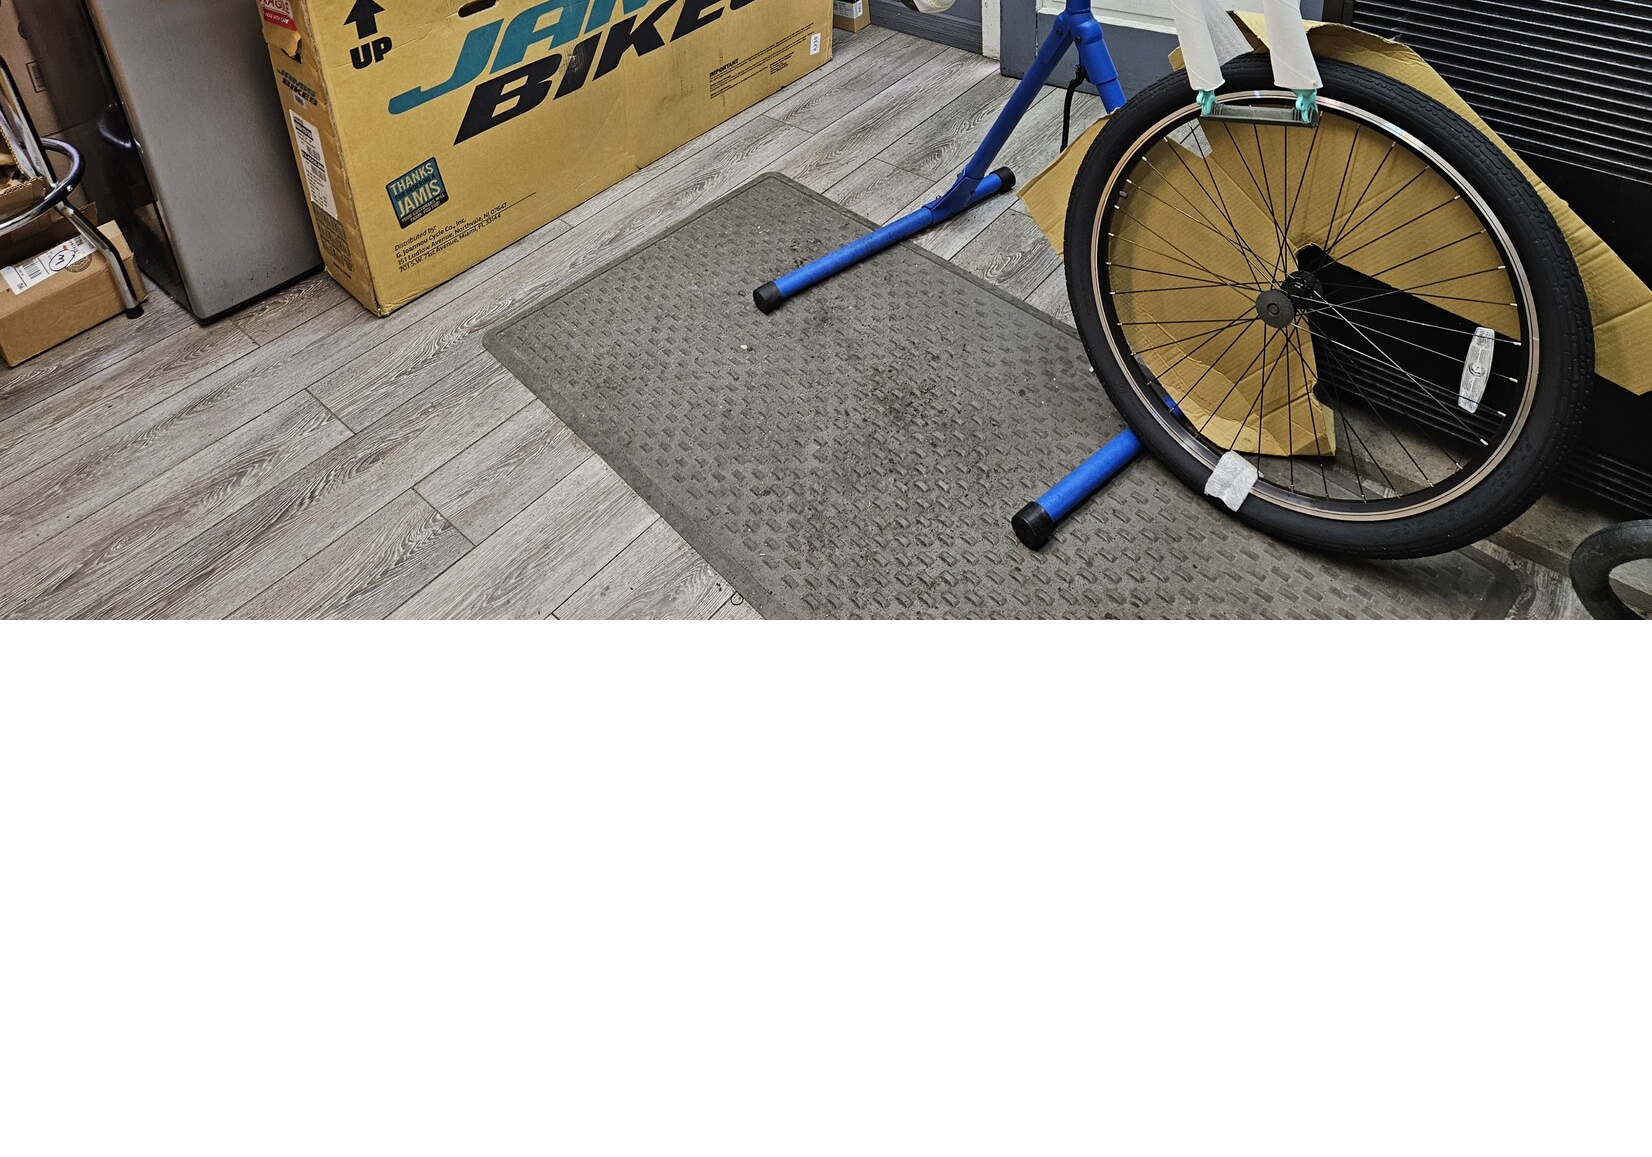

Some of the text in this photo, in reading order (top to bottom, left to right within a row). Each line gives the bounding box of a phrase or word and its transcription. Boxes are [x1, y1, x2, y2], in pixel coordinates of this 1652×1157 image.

[349, 36, 393, 70] UP
[708, 57, 738, 78] IMPORTANT
[282, 77, 319, 106] BIKES
[390, 162, 434, 195] THANKS
[395, 191, 406, 201] FOR
[397, 179, 441, 217] JAMIS
[401, 193, 444, 222] YOUR CUSTOMERS WILL
[410, 212, 422, 222] THANK
[486, 212, 501, 224] 33144
[394, 225, 436, 251] Distributed by:
[398, 257, 407, 265] 151
[408, 245, 430, 259] Ludlow
[490, 202, 506, 214] 07647
[403, 238, 428, 255] Joannou
[429, 229, 444, 241] Cycle
[456, 217, 466, 226] Inc.
